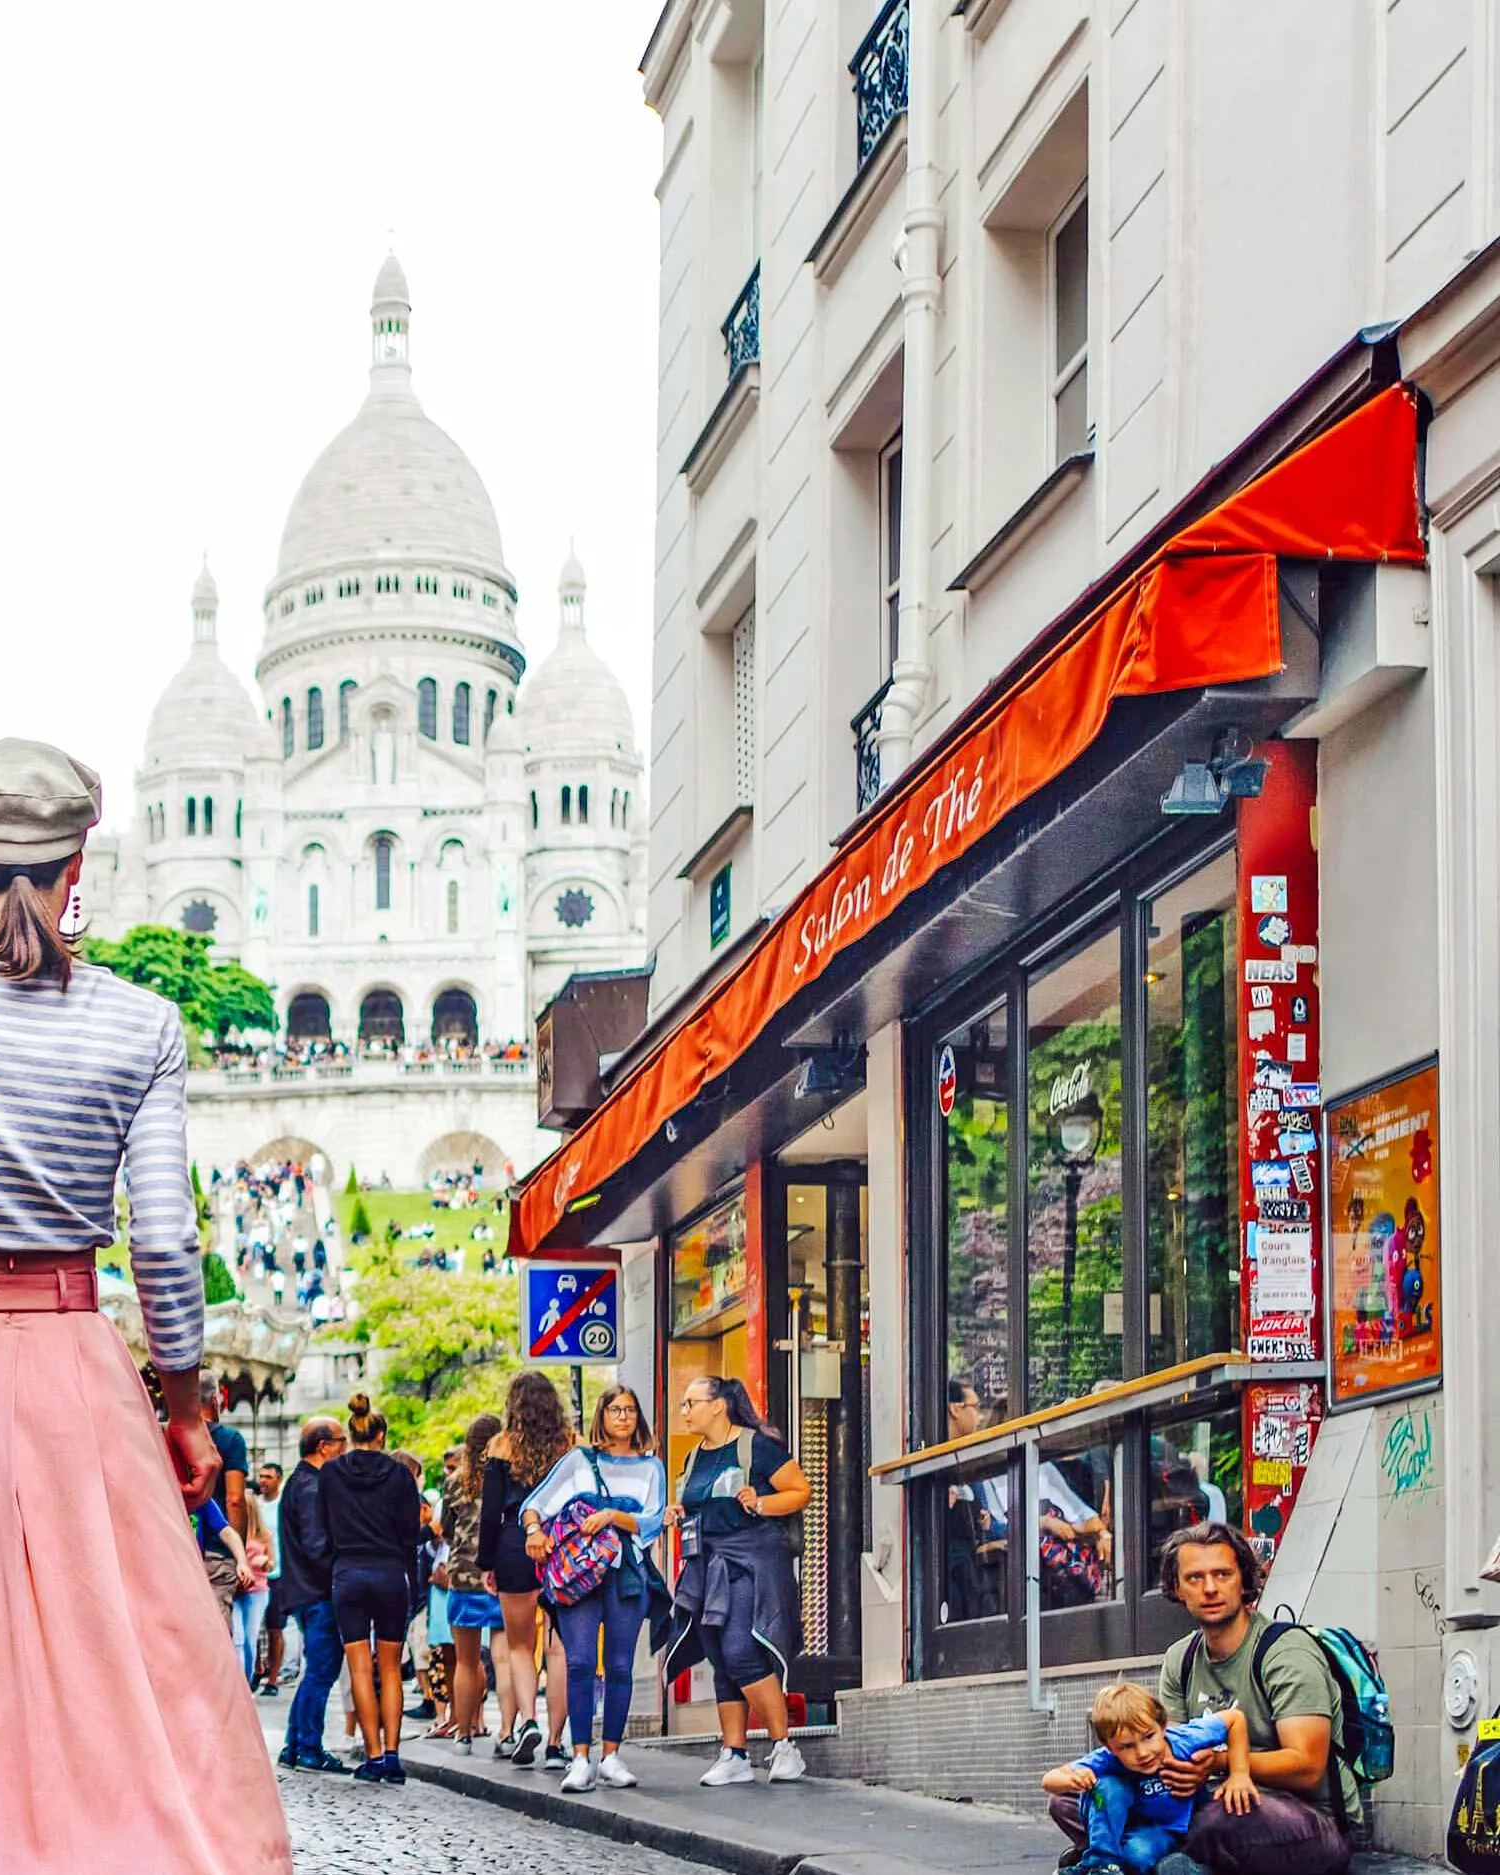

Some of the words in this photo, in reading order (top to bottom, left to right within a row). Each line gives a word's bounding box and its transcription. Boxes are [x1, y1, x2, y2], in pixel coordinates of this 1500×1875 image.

[793, 875, 872, 974] Salon
[881, 820, 914, 897] de
[923, 756, 984, 855] Thé
[1247, 961, 1295, 981] NEAS
[1261, 1240, 1291, 1251] Cours
[1261, 1255, 1306, 1267] d'anglais
[1253, 1317, 1303, 1332] JOKER
[588, 1332, 608, 1345] 20
